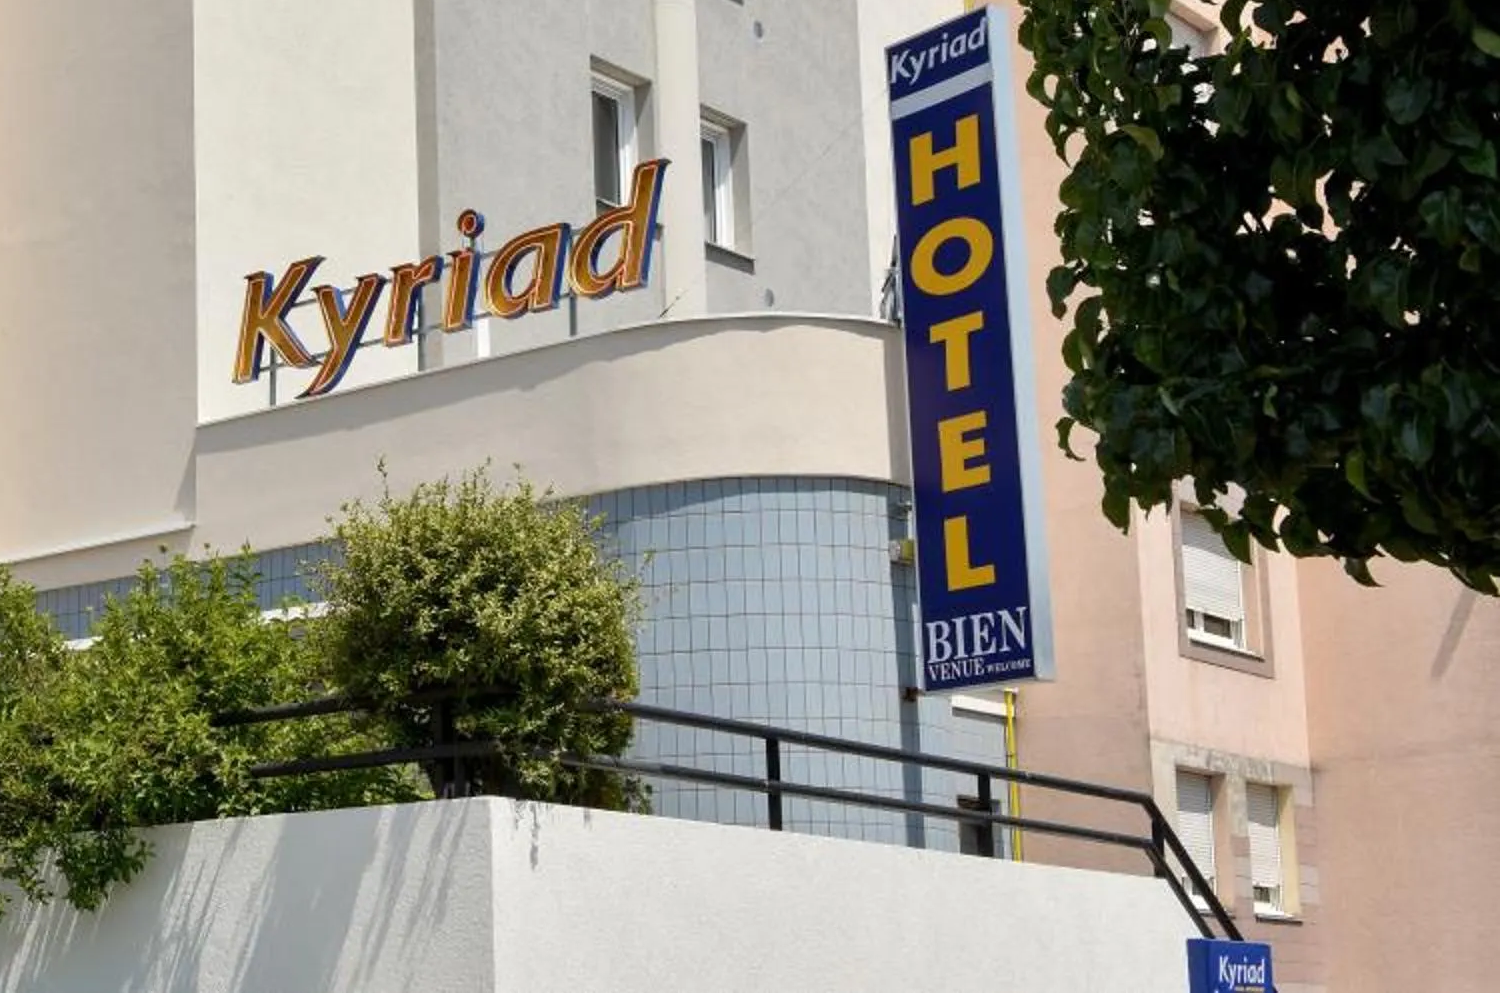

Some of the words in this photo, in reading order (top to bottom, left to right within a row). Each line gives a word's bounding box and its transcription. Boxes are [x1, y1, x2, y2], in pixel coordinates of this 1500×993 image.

[890, 16, 988, 85] Kyriad
[231, 158, 671, 399] Kyriad
[909, 113, 996, 592] HOTEL
[926, 606, 1027, 664] BIEN
[928, 657, 985, 682] VENUE
[1219, 954, 1265, 990] Kyriad
